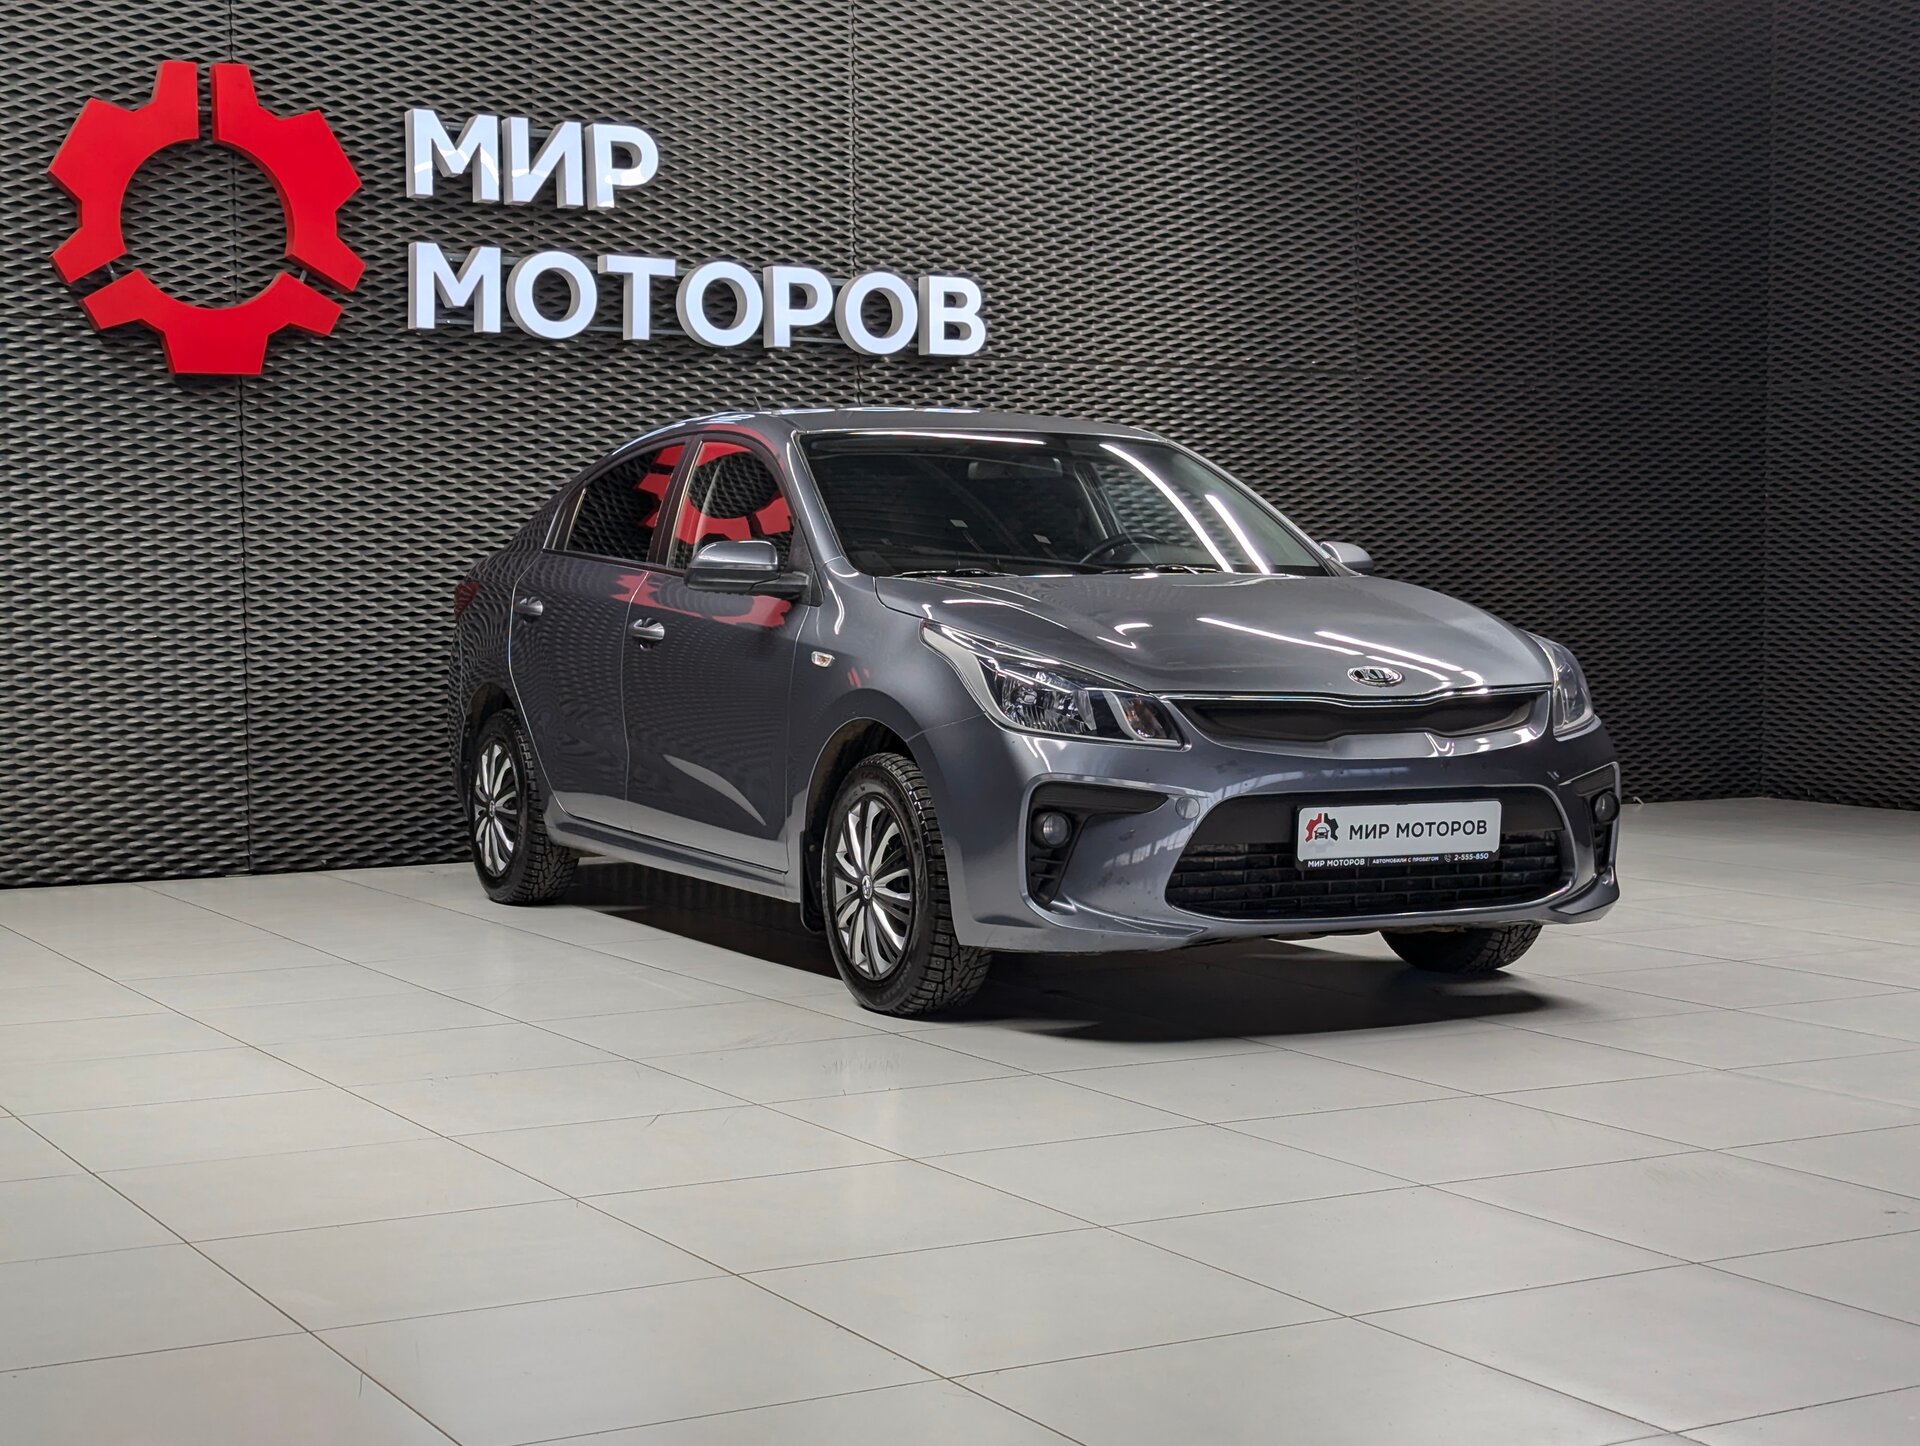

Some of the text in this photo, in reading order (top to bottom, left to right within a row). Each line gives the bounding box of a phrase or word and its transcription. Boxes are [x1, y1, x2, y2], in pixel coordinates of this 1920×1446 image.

[405, 108, 659, 210] МИР
[407, 241, 987, 356] МОТОРОВ
[1307, 860, 1325, 868] МИР
[1326, 858, 1366, 867] МОТОРОВ
[1454, 852, 1489, 861] 2-555-850
[1349, 820, 1488, 840] МИР МОТОРОВ
